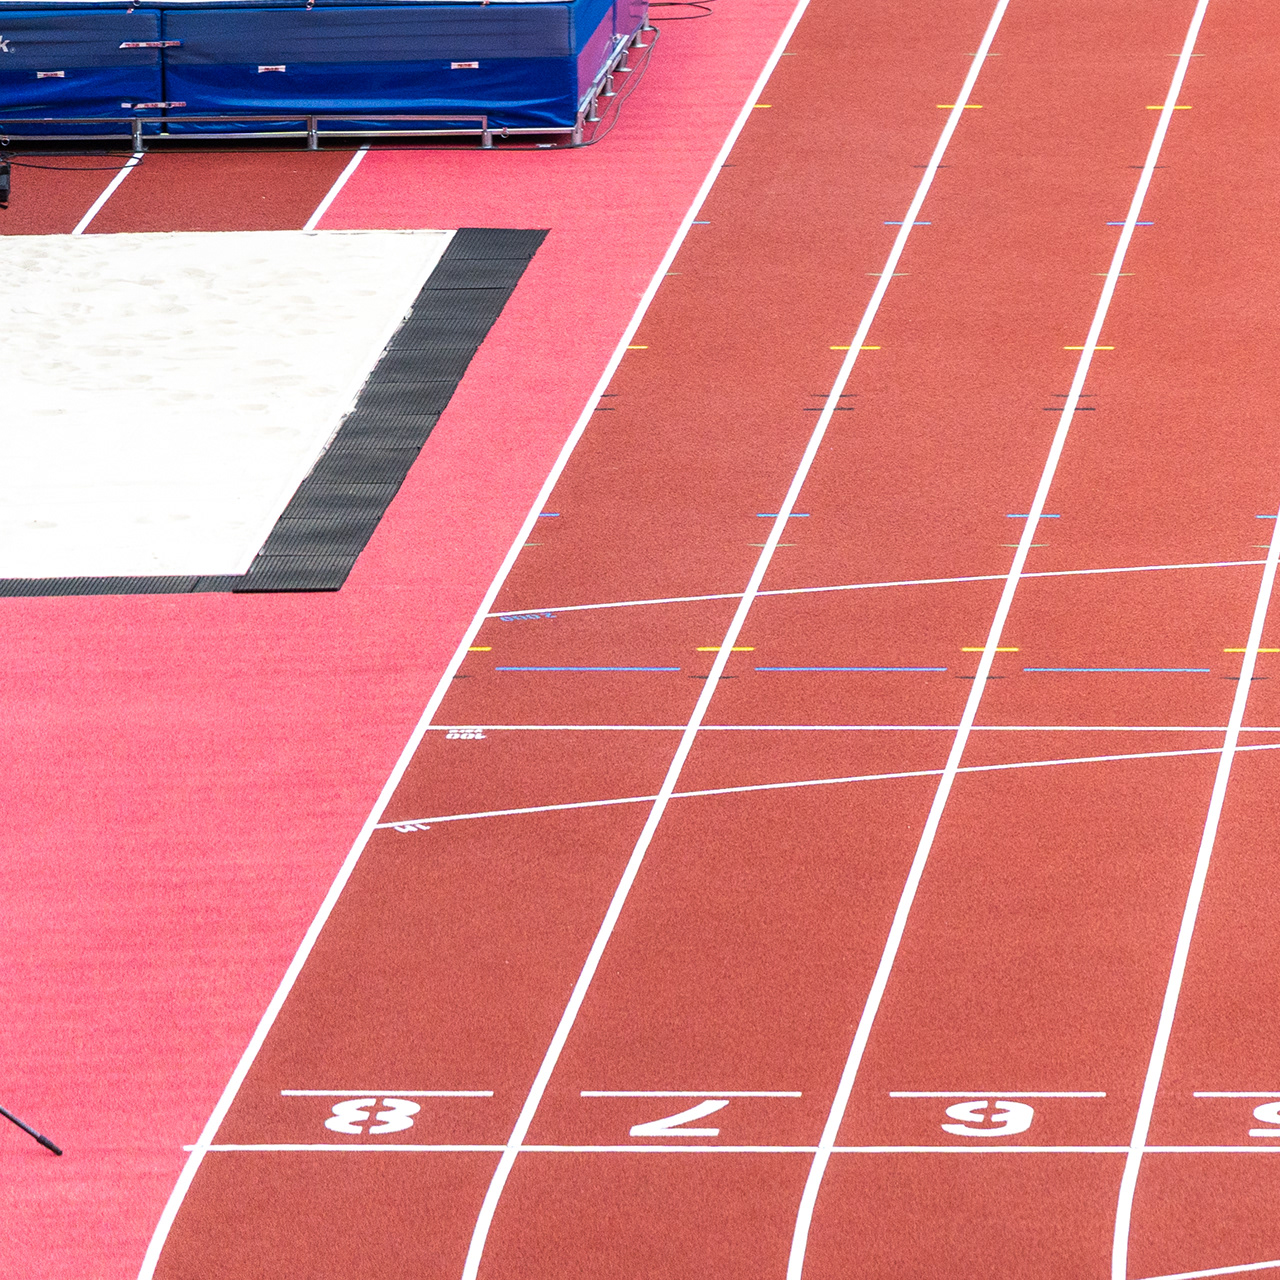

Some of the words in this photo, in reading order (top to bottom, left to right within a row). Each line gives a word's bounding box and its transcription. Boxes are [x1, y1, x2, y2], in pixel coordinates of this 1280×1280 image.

[324, 1098, 420, 1134] 8
[629, 1099, 730, 1136] 7
[941, 1100, 1036, 1137] 6
